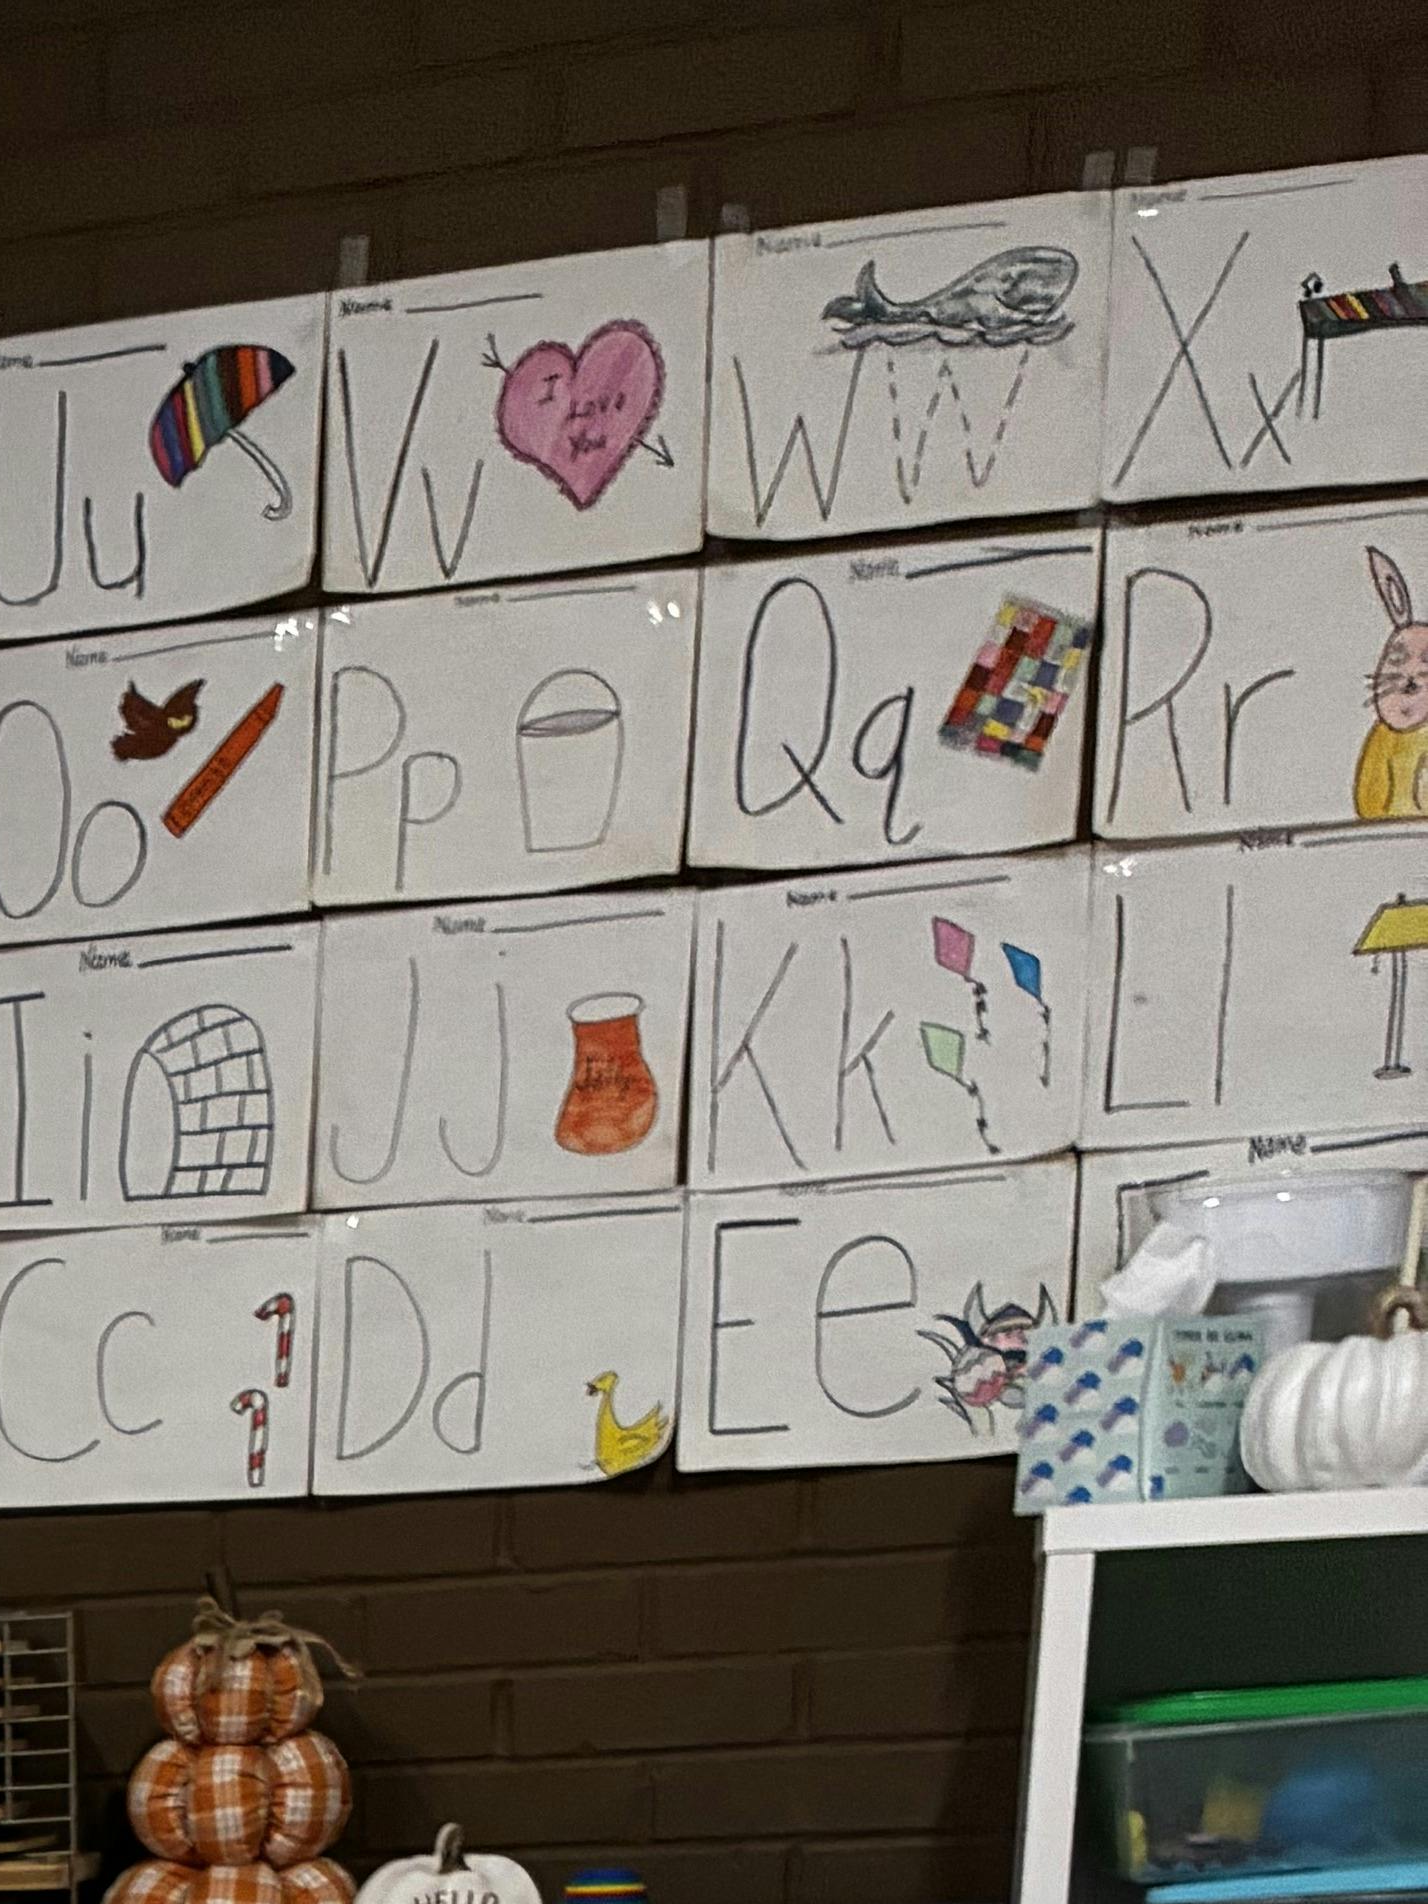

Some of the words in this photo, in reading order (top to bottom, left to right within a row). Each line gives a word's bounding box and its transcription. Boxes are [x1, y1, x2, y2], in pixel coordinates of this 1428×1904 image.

[757, 234, 823, 256] Name
[337, 337, 484, 590] Vv
[537, 372, 562, 406] I
[1110, 230, 1306, 490] Xx
[66, 643, 108, 670] Name
[734, 575, 924, 848] Qq
[1105, 565, 1297, 826] Rr
[322, 664, 464, 894] Pp
[79, 943, 132, 973] Name
[433, 914, 486, 936] Name
[785, 889, 838, 910] Name
[329, 948, 510, 1186] Jj
[707, 917, 897, 1175] Kk
[1247, 1135, 1306, 1165] Name
[336, 1248, 493, 1464] Dd
[706, 1216, 924, 1439] Ee
